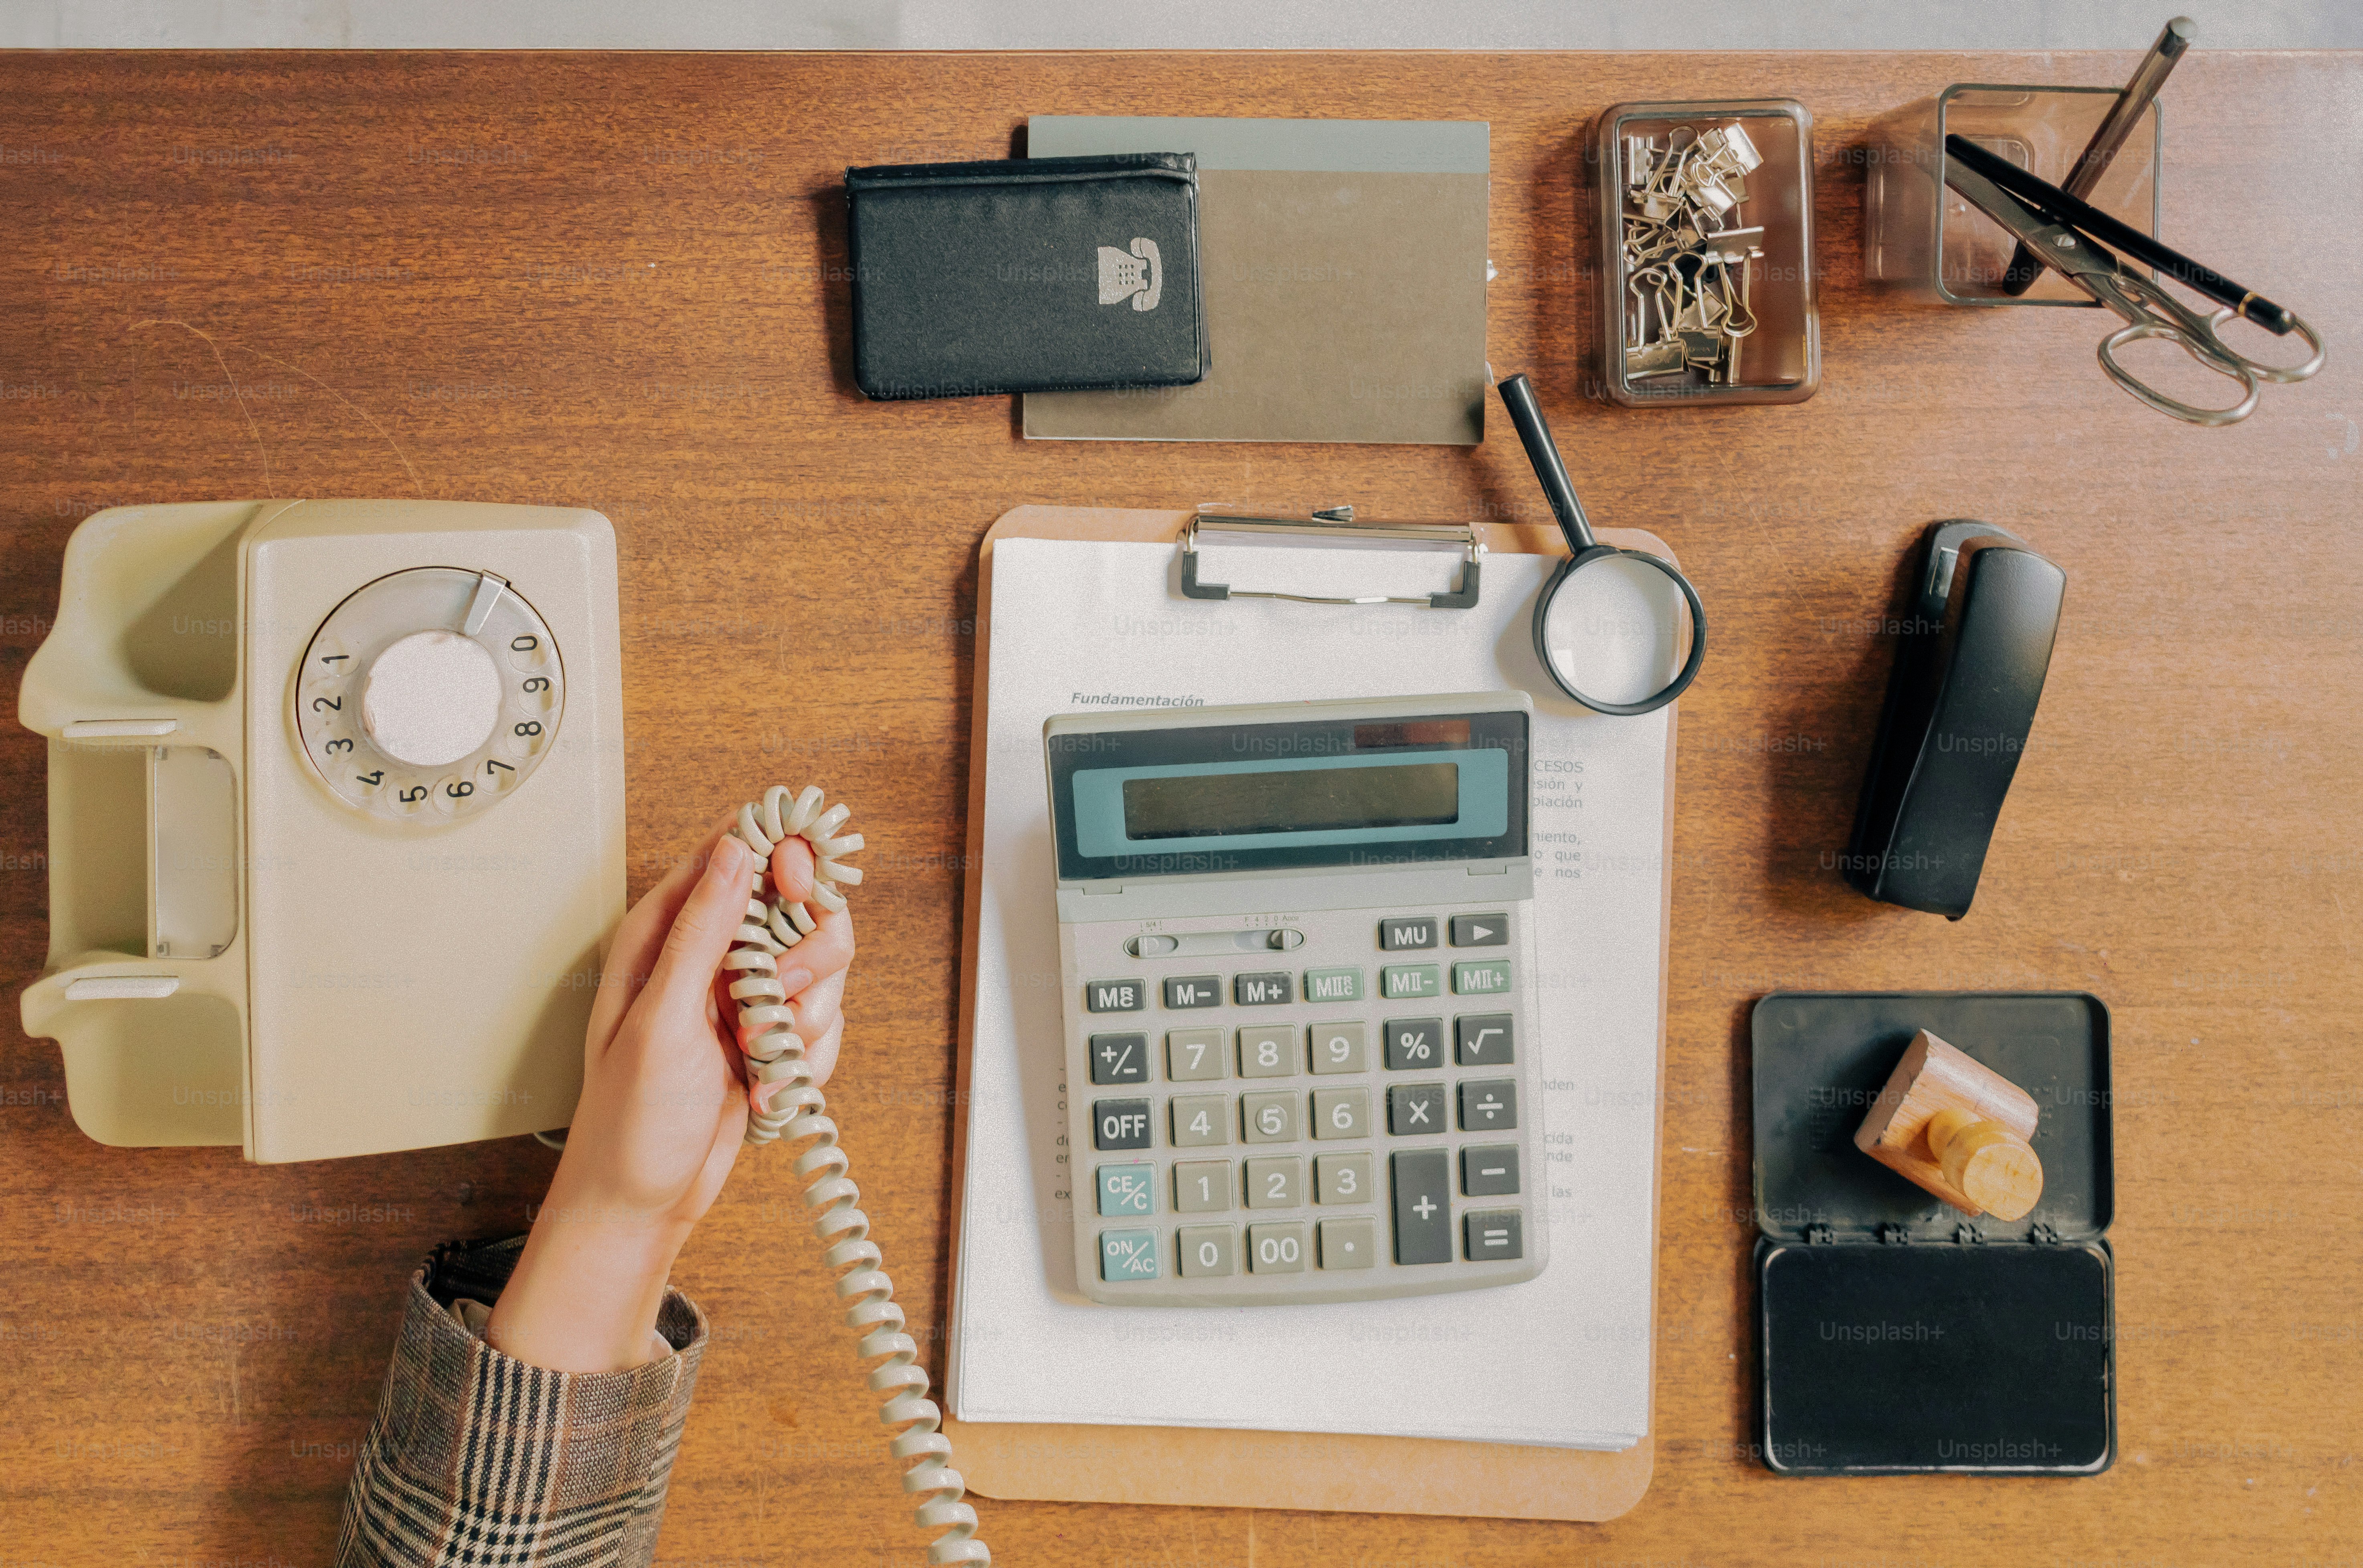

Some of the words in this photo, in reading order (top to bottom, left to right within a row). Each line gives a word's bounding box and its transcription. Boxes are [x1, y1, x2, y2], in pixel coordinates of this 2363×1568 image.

[511, 635, 538, 652] 0
[321, 654, 350, 665] 1
[522, 677, 550, 694] 9
[313, 695, 342, 713] 2
[1071, 692, 1205, 707] Fundamentación
[514, 720, 542, 737] 8
[325, 737, 354, 756] 3
[487, 759, 515, 775] 7
[356, 770, 385, 787] 4
[446, 780, 475, 798] 6
[1534, 776, 1565, 790] sión
[1575, 782, 1583, 794] y
[400, 785, 428, 803] 5
[1555, 851, 1581, 863] que
[1556, 868, 1581, 879] nos
[1393, 925, 1427, 946] MU
[1246, 981, 1283, 1002] M+
[1186, 1043, 1206, 1070] 7
[1257, 1041, 1280, 1067] 8
[1328, 1035, 1351, 1063] 9
[1400, 1032, 1430, 1061] %
[1102, 1113, 1147, 1140] OFF
[1189, 1110, 1211, 1136] 4
[1261, 1108, 1281, 1136] 5
[1332, 1103, 1353, 1130] 6
[1197, 1176, 1209, 1202] 1
[1267, 1172, 1287, 1199] 2
[1337, 1168, 1357, 1196] 3
[1198, 1241, 1219, 1268] 0
[1259, 1237, 1300, 1264] 00
